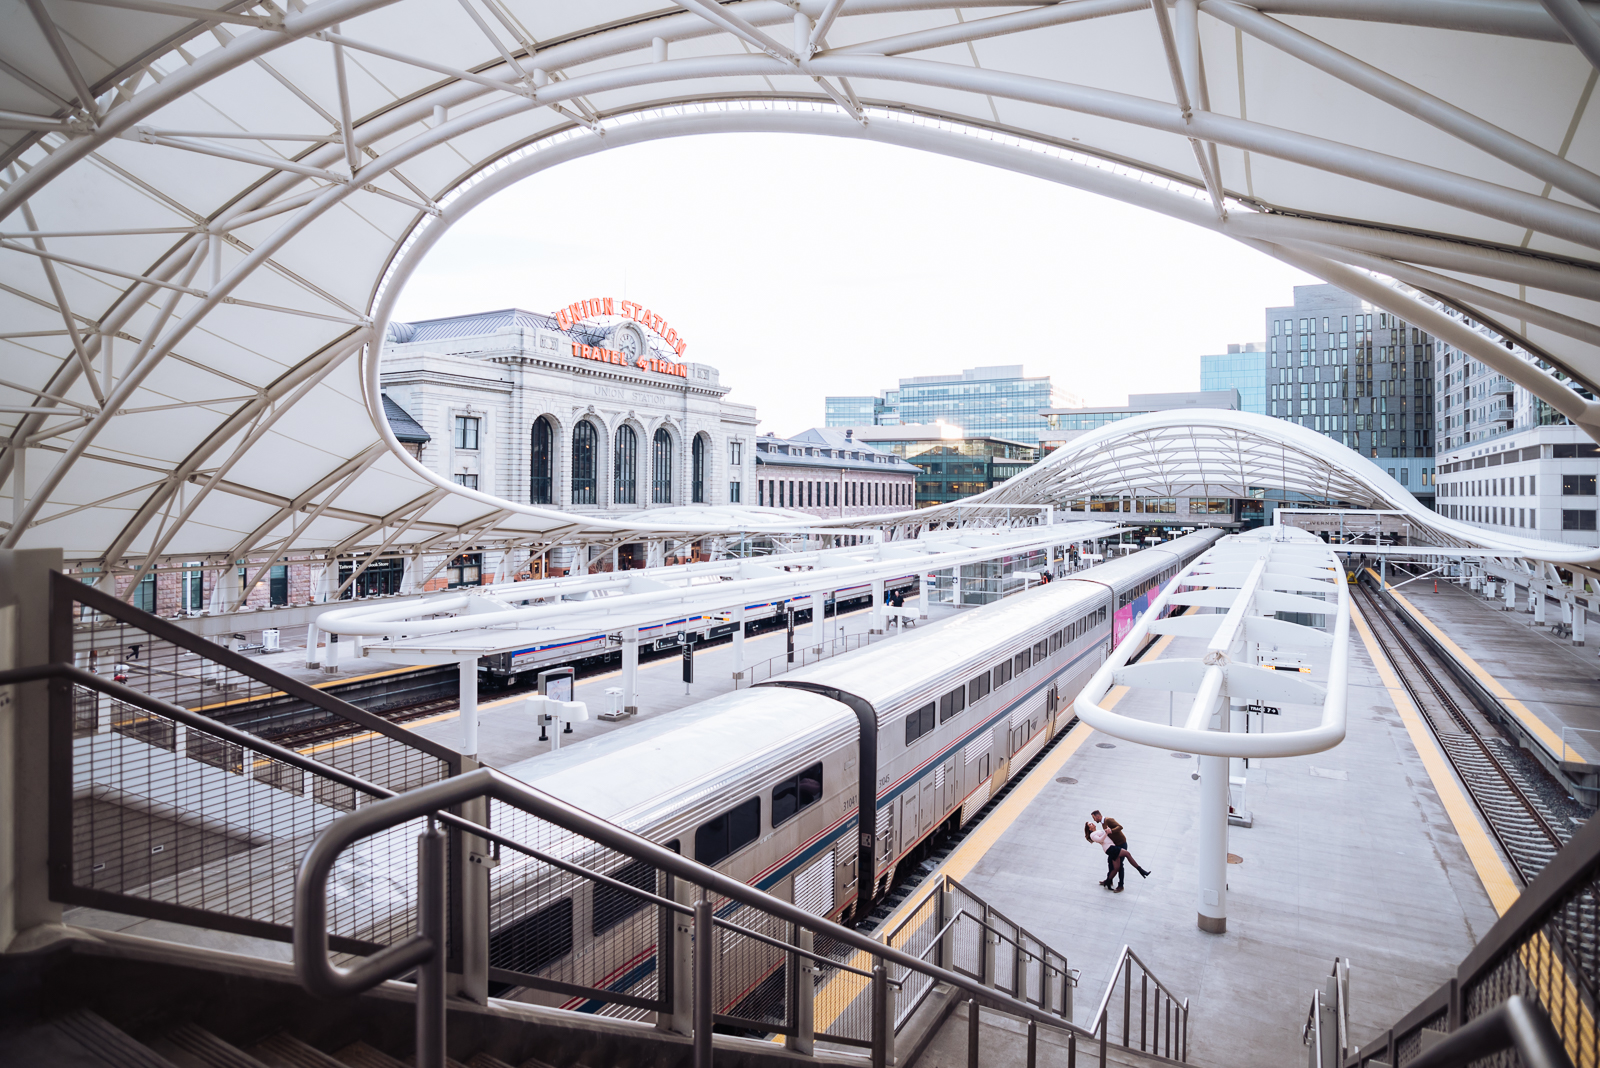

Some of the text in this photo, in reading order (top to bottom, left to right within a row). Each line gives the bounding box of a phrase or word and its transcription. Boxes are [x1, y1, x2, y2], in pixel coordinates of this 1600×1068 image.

[556, 297, 687, 358] UNION STATION
[572, 342, 687, 378] TRAVEL by TRAIN
[594, 386, 666, 405] UNION STATION
[843, 794, 858, 811] 31041
